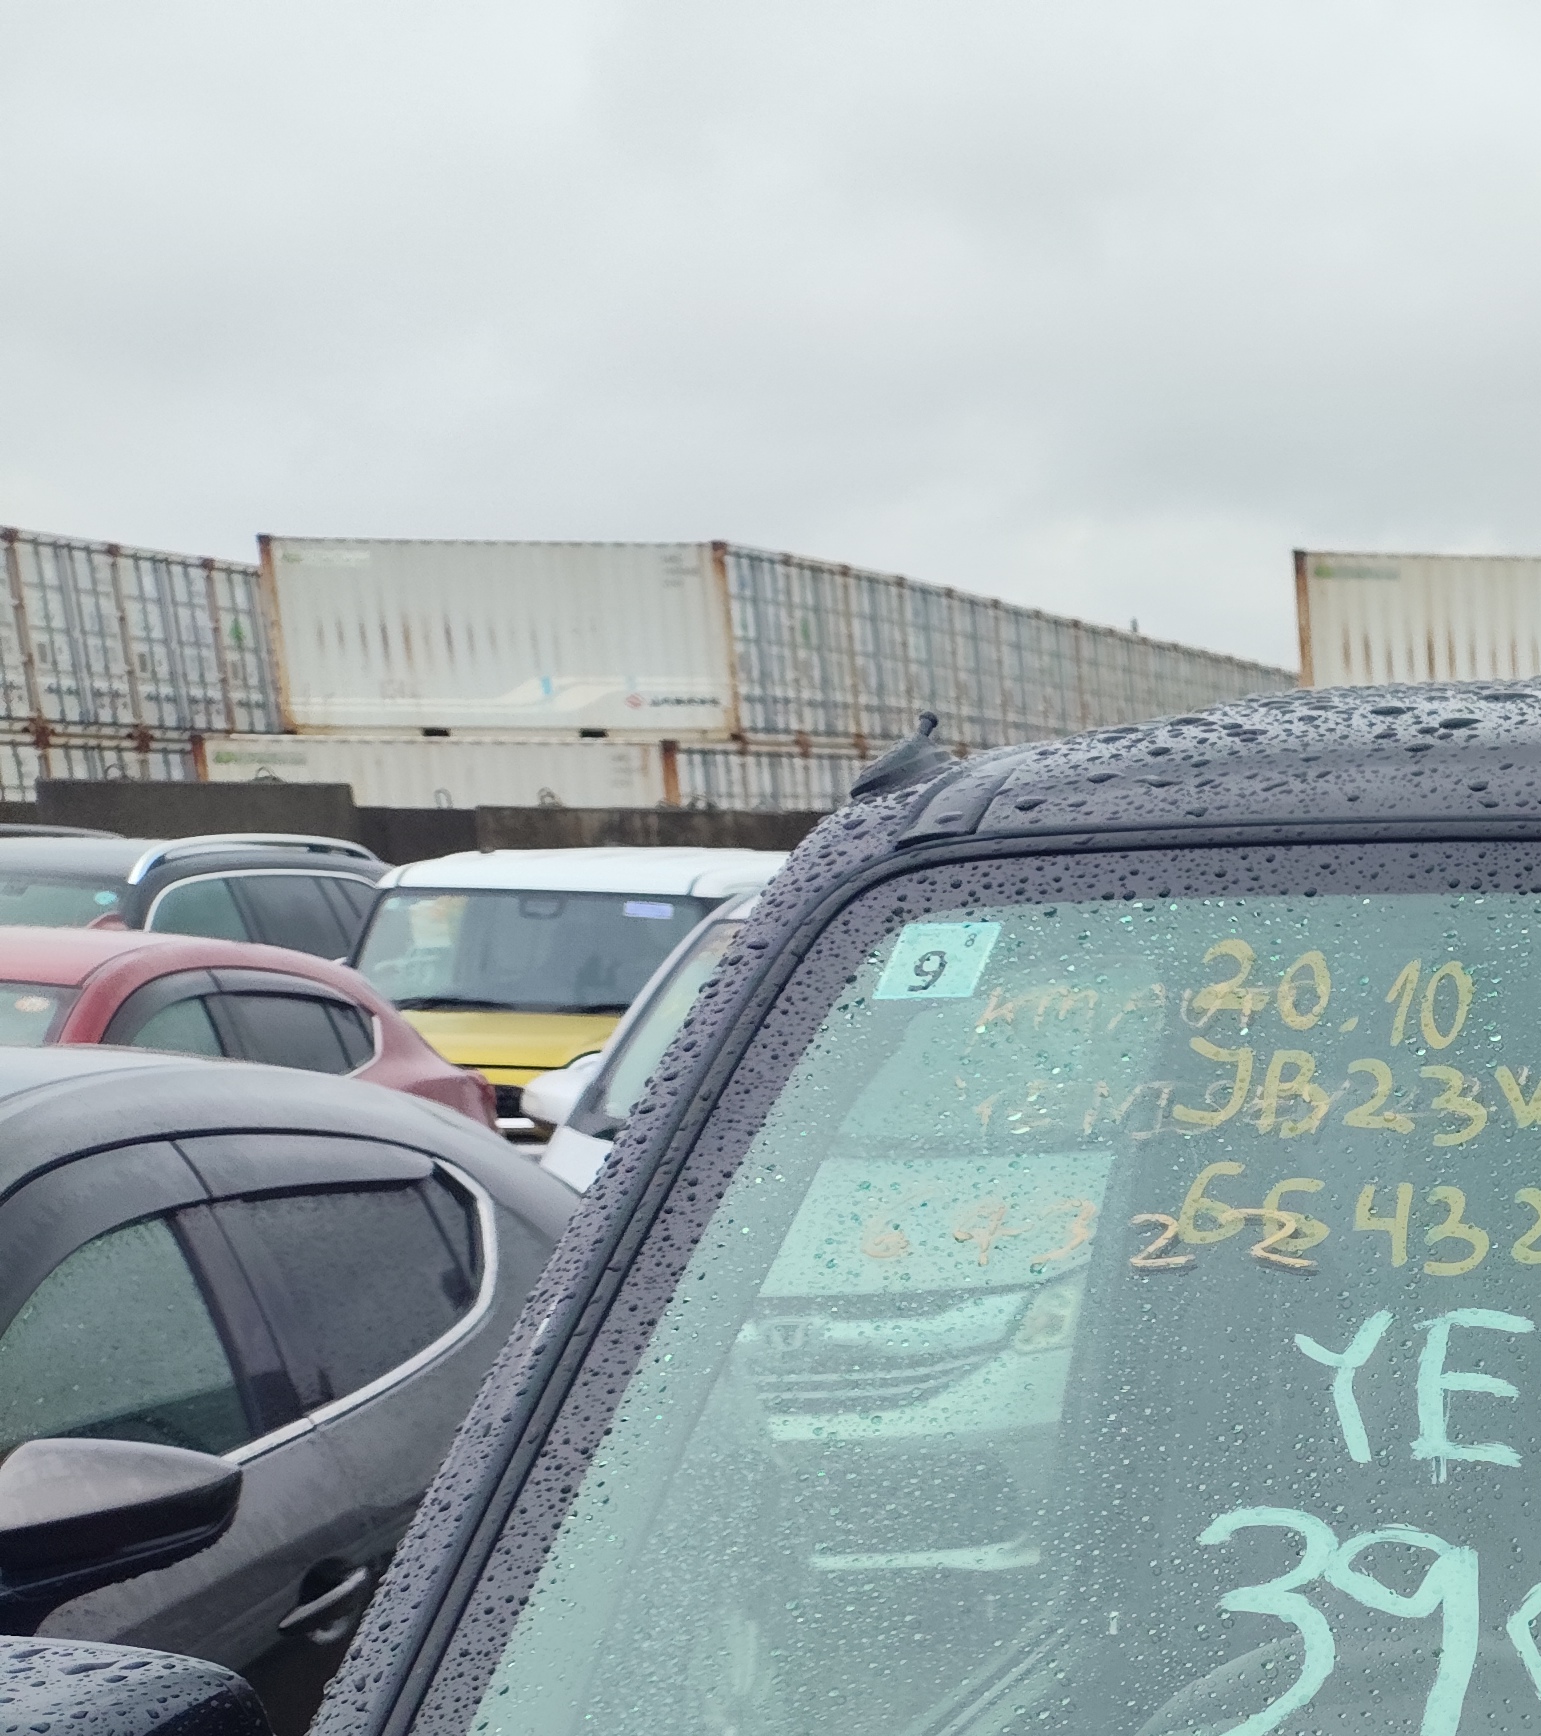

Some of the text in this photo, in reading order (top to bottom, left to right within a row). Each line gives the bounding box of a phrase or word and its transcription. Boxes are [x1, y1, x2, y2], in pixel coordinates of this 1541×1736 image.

[965, 933, 977, 948] 8
[907, 950, 948, 992] 9
[1294, 1306, 1535, 1484] YE
